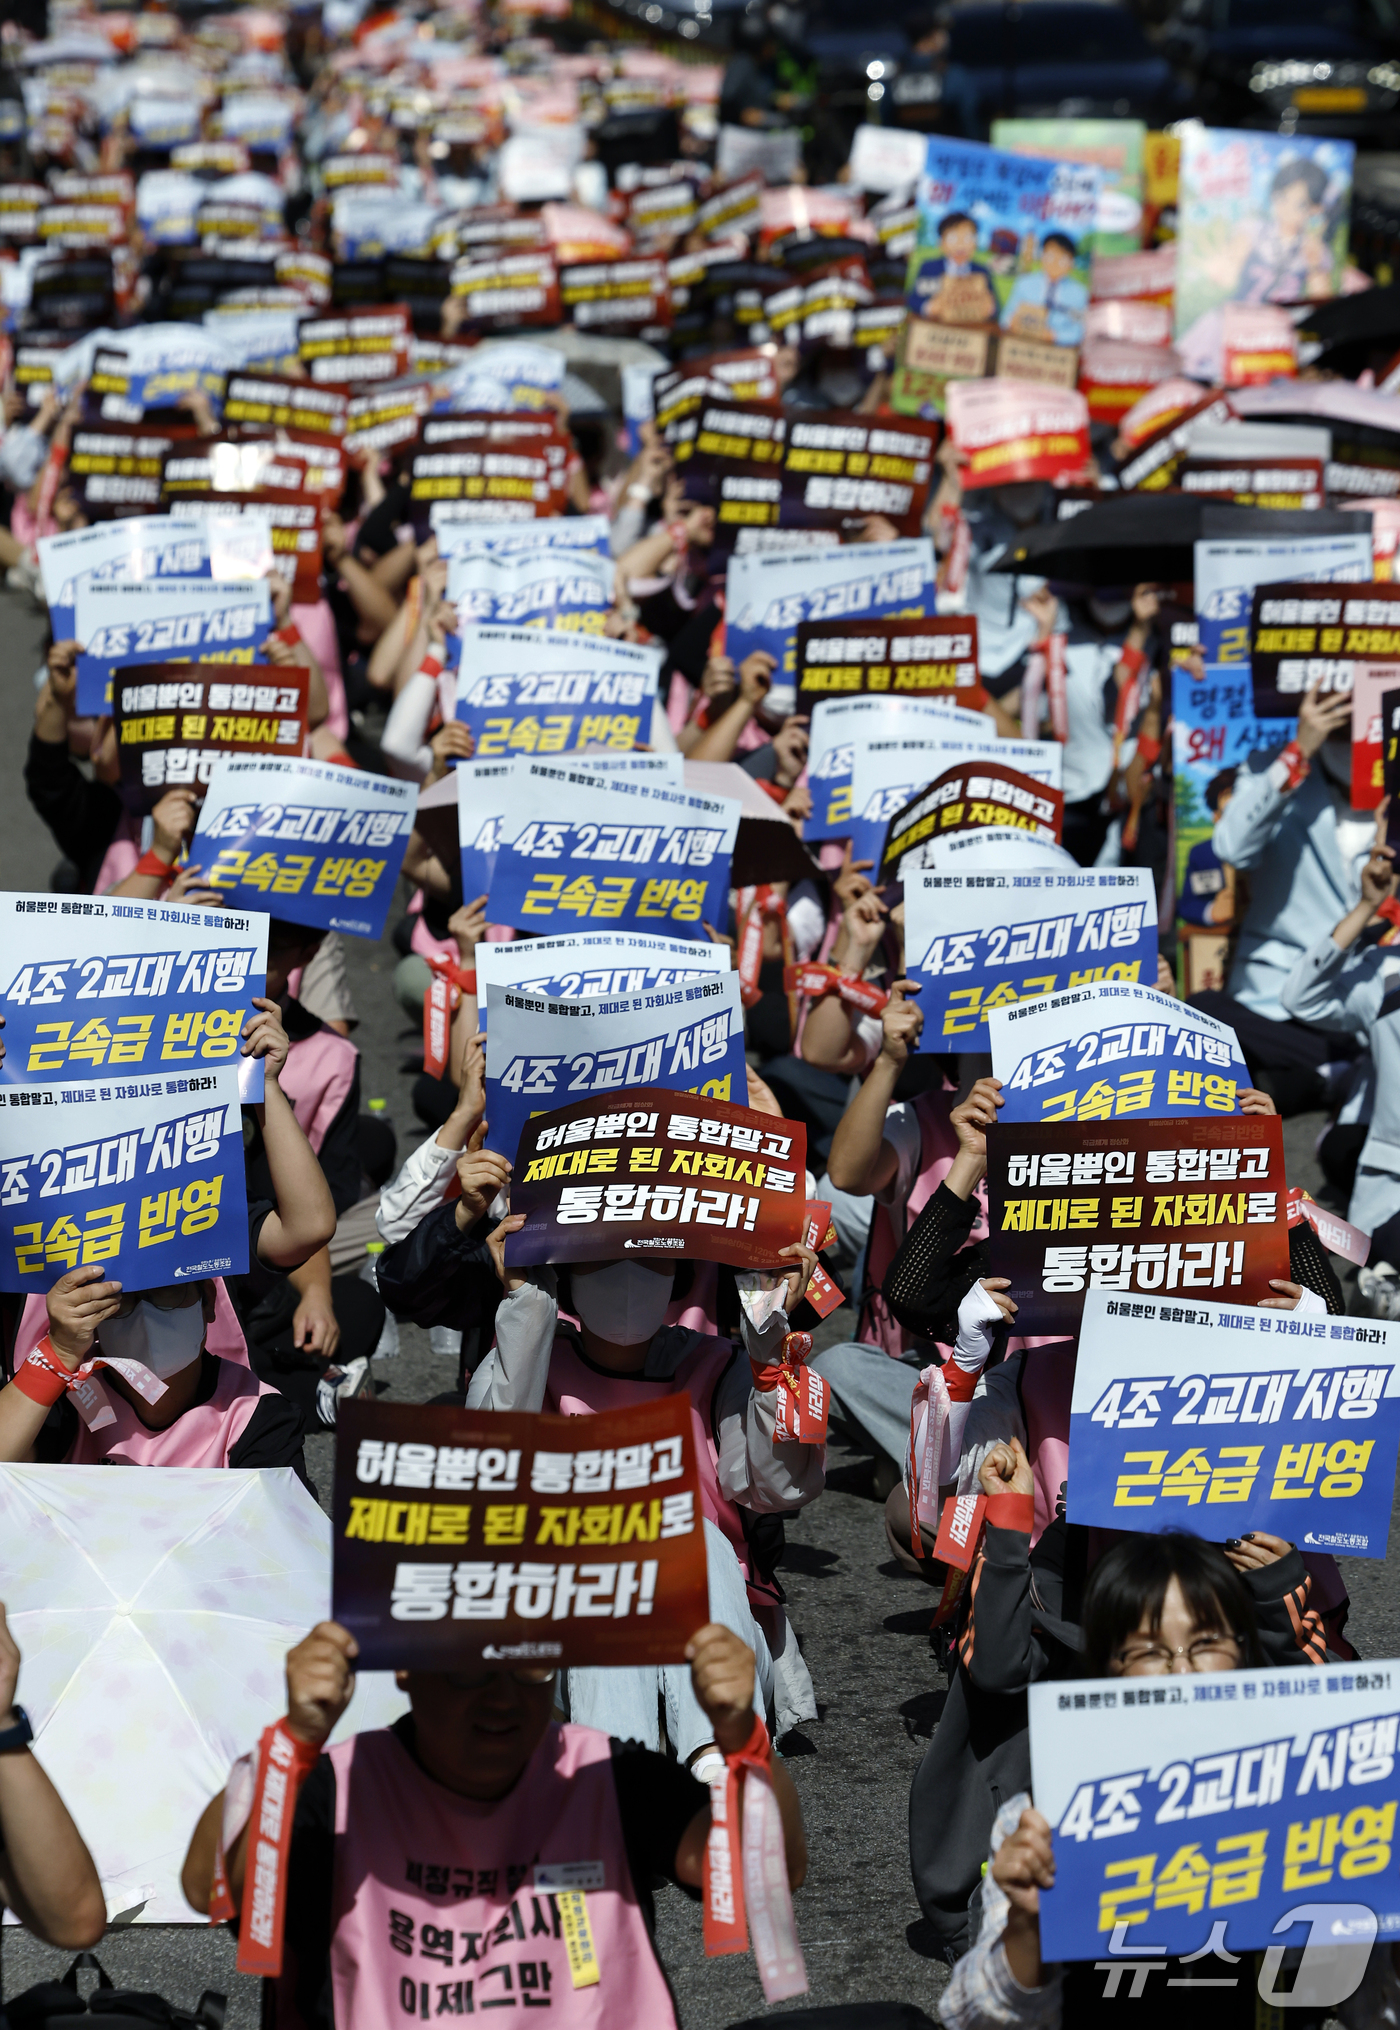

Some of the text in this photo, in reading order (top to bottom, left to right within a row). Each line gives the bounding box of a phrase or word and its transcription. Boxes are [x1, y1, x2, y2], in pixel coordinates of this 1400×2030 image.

[122, 683, 300, 713] 허울뿐인 통합말고
[466, 673, 647, 708] 4조 2교대 시행
[121, 715, 301, 745] 제대로 된 자회사로
[477, 715, 573, 755] 근속급
[940, 803, 966, 828] 된
[966, 776, 1056, 823] 통합말고
[206, 807, 404, 847] 4조 2교대 시행
[513, 824, 723, 866] 4조 2교대 시행
[209, 850, 387, 898] 근속급 반영
[520, 874, 709, 921] 근속급 반영
[923, 875, 1139, 889] 허울뿐인 통합말고, 제대로 된 자회사로 통합하라!
[16, 901, 250, 932] 허울뿐인 통합말고, 제대로 된 자회사로 통합하라!
[921, 903, 1146, 976] 4조 2교대 시행
[6, 950, 254, 1006] 4조 2교대 시행
[505, 982, 724, 1017] 허울뿐인 통합말고, 제대로 된 자회사로 통합하라!
[1007, 986, 1222, 1032] 허울뿐인 통합말고, 제대로 된 자회사로 통합하라!
[27, 1009, 246, 1072] 근속급 반영
[500, 1012, 731, 1093] 4조 2교대 시행
[1011, 1024, 1233, 1092] 4조 2교대 시행
[10, 1092, 58, 1107] 통합말고,
[61, 1090, 96, 1104] 제대로
[99, 1087, 111, 1101] 된
[115, 1084, 162, 1100] 자회사로
[165, 1076, 217, 1093] 통합하라!
[1041, 1069, 1238, 1122] 근속급 반영
[39, 1110, 224, 1198] 2교대 시행
[535, 1112, 792, 1161] 허울뿐인 통합말고
[523, 1147, 797, 1194] 제대로 된 자회사로
[1007, 1147, 1270, 1188] 허울뿐인 통합말고
[13, 1175, 224, 1274] 근속급 반영
[556, 1184, 760, 1233] 통합하라!
[1001, 1198, 1100, 1232] 제대로
[1110, 1196, 1144, 1229] 된
[1151, 1192, 1278, 1227] 자회사로
[1042, 1241, 1245, 1293] 통합하라!
[1107, 1301, 1387, 1345] 허울뿐인 통합말고, 제대로 된 자회사로 통합하라!
[1090, 1368, 1389, 1429] 4조 2교대 시행
[356, 1435, 685, 1494] 허울뿐인 통합말고
[1113, 1440, 1376, 1507] 근속급 반영
[345, 1490, 695, 1547] 제대로 된 자회사로
[390, 1559, 659, 1621] 통합하라!
[1058, 1672, 1392, 1711] 허울뿐인 통합말고, 제대로 된 자회사로 통합하라!
[1059, 1714, 1400, 1843] 4조 2교대 시행
[1098, 1801, 1399, 1933] 근속급 반영
